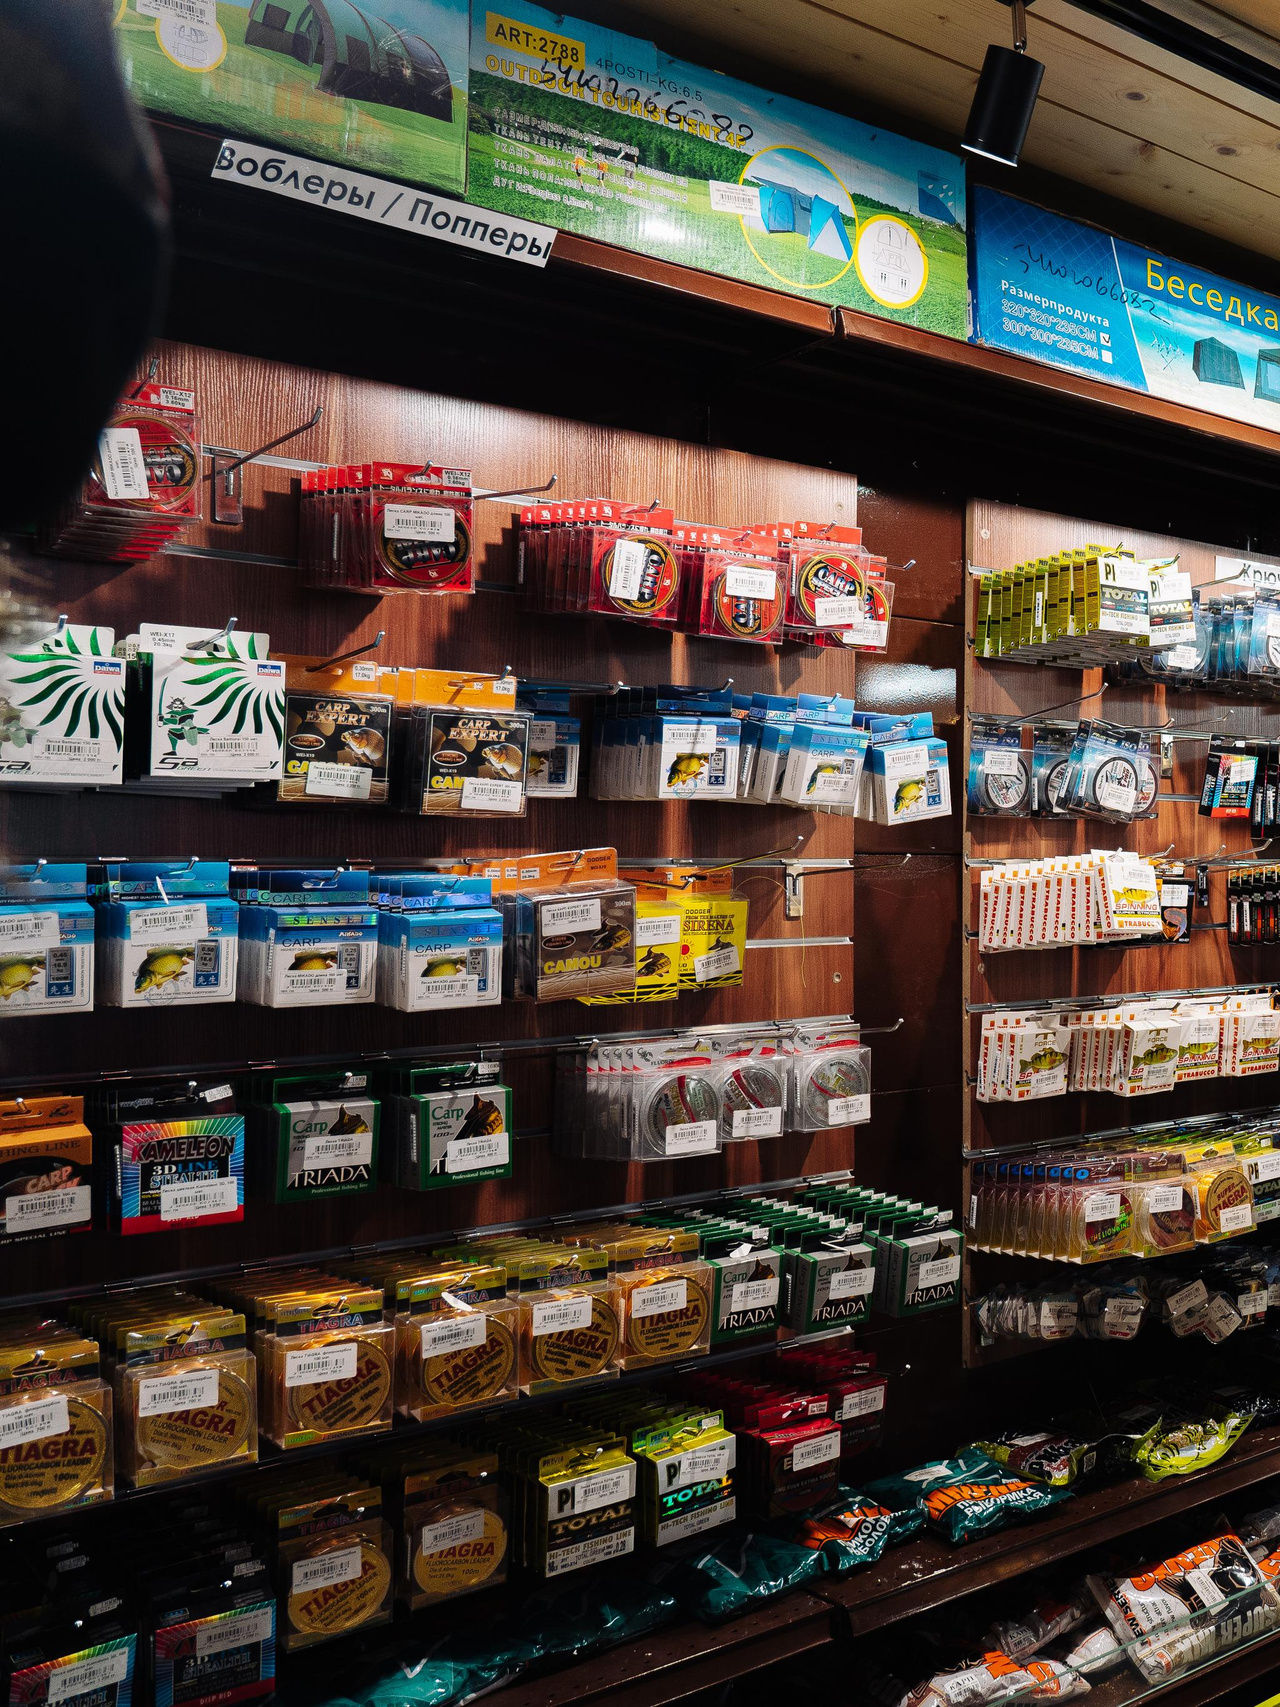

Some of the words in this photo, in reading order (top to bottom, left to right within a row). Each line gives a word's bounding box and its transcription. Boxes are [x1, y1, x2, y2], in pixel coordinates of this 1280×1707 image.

[495, 23, 579, 63] ART:2788
[494, 123, 530, 142] ТКАНЬ
[494, 141, 530, 159] ТКАНЬ
[493, 158, 530, 176] ТКАНЬ
[215, 145, 375, 210] Воблеры
[409, 198, 553, 261] Попперы
[1146, 257, 1280, 332] Беседка
[1001, 279, 1110, 327] Размерпродукта
[162, 389, 192, 398] WEI-X12
[818, 567, 855, 593] CARP
[1102, 587, 1147, 603] TOTAL
[1150, 601, 1192, 615] TOTAL
[94, 663, 121, 673] Daiwa
[258, 665, 281, 674] Daiwa
[315, 701, 351, 713] CARP
[369, 705, 387, 714] 300m
[766, 711, 790, 719] CARP
[305, 711, 370, 726] EXPERT
[458, 719, 491, 730] CARP
[448, 728, 510, 742] EXPERT
[811, 749, 835, 757] CARP
[1121, 741, 1137, 751] ISO
[1100, 876, 1112, 928] TRABUCCO
[1115, 903, 1158, 911] SPINNING
[293, 915, 365, 925] SENSEI
[683, 919, 734, 931] SIRENA
[424, 925, 491, 936] SENSEI
[282, 938, 322, 947] CARP
[415, 943, 452, 954] CARP
[543, 955, 601, 975] CAMOU
[197, 975, 218, 986] 先生
[1231, 1025, 1239, 1073] TRABUCCO
[1242, 1048, 1278, 1057] SPINNING
[1178, 1053, 1216, 1064] SPINNING
[1183, 1069, 1215, 1078] TRABUCCO
[1247, 1063, 1277, 1073] TRABUCCO
[431, 1106, 464, 1121] Carp
[292, 1119, 328, 1135] Carp
[45, 1139, 82, 1151] LINE
[131, 1135, 237, 1163] KAMELEON
[152, 1165, 176, 1176] 3D
[177, 1160, 218, 1171] LINE
[452, 1171, 478, 1180] Professional
[26, 1166, 74, 1193] CARP
[150, 1171, 219, 1188] STEALTH
[290, 1165, 369, 1188] TRIADA
[1217, 1182, 1236, 1201] SUPER
[1211, 1185, 1248, 1217] TIAGRA
[14, 1233, 47, 1243] SPECIAL
[633, 1253, 684, 1271] TIAGRA
[909, 1251, 931, 1264] Carp
[537, 1270, 593, 1288] TIAGRA
[722, 1271, 747, 1285] Carp
[817, 1265, 841, 1279] Carp
[906, 1284, 955, 1305] TRIADA
[640, 1305, 701, 1329] TIAGRA
[813, 1300, 865, 1321] TRIADA
[299, 1313, 364, 1333] TIAGRA
[718, 1307, 775, 1331] TRIADA
[150, 1339, 224, 1361] TIAGRA
[430, 1335, 504, 1389] TIAGRA
[0, 1370, 78, 1395] TIAGRA
[302, 1357, 382, 1415] TIAGRA
[313, 1385, 360, 1422] FLUOROCARBON
[150, 1419, 203, 1438] FLUOROCARBON
[203, 1431, 229, 1444] LEADER
[0, 1437, 98, 1464] TIAGRA
[191, 1443, 213, 1454] 100m
[62, 1459, 92, 1468] LEADER
[180, 1456, 249, 1475] FLUOROCARBON
[662, 1474, 733, 1509] TOTAL
[552, 1503, 631, 1535] TOTAL
[660, 1517, 688, 1531] HI-TECH
[690, 1505, 718, 1522] FISHING
[720, 1498, 734, 1510] LINE
[697, 1517, 710, 1527] GREEN
[549, 1544, 581, 1560] HI-TECH
[583, 1534, 613, 1550] FISHING
[616, 1529, 632, 1541] LINE
[426, 1559, 469, 1567] FLUOROCARBON
[462, 1567, 480, 1576] 100m
[300, 1561, 377, 1617] TIAGRA
[355, 1586, 376, 1601] 100m
[310, 1588, 355, 1624] FLUOROCARBON
[353, 1572, 379, 1592] LEADER
[1221, 1605, 1276, 1646] SUPER
[949, 1674, 975, 1691] КАРП
[200, 1694, 218, 1705] DEEP
